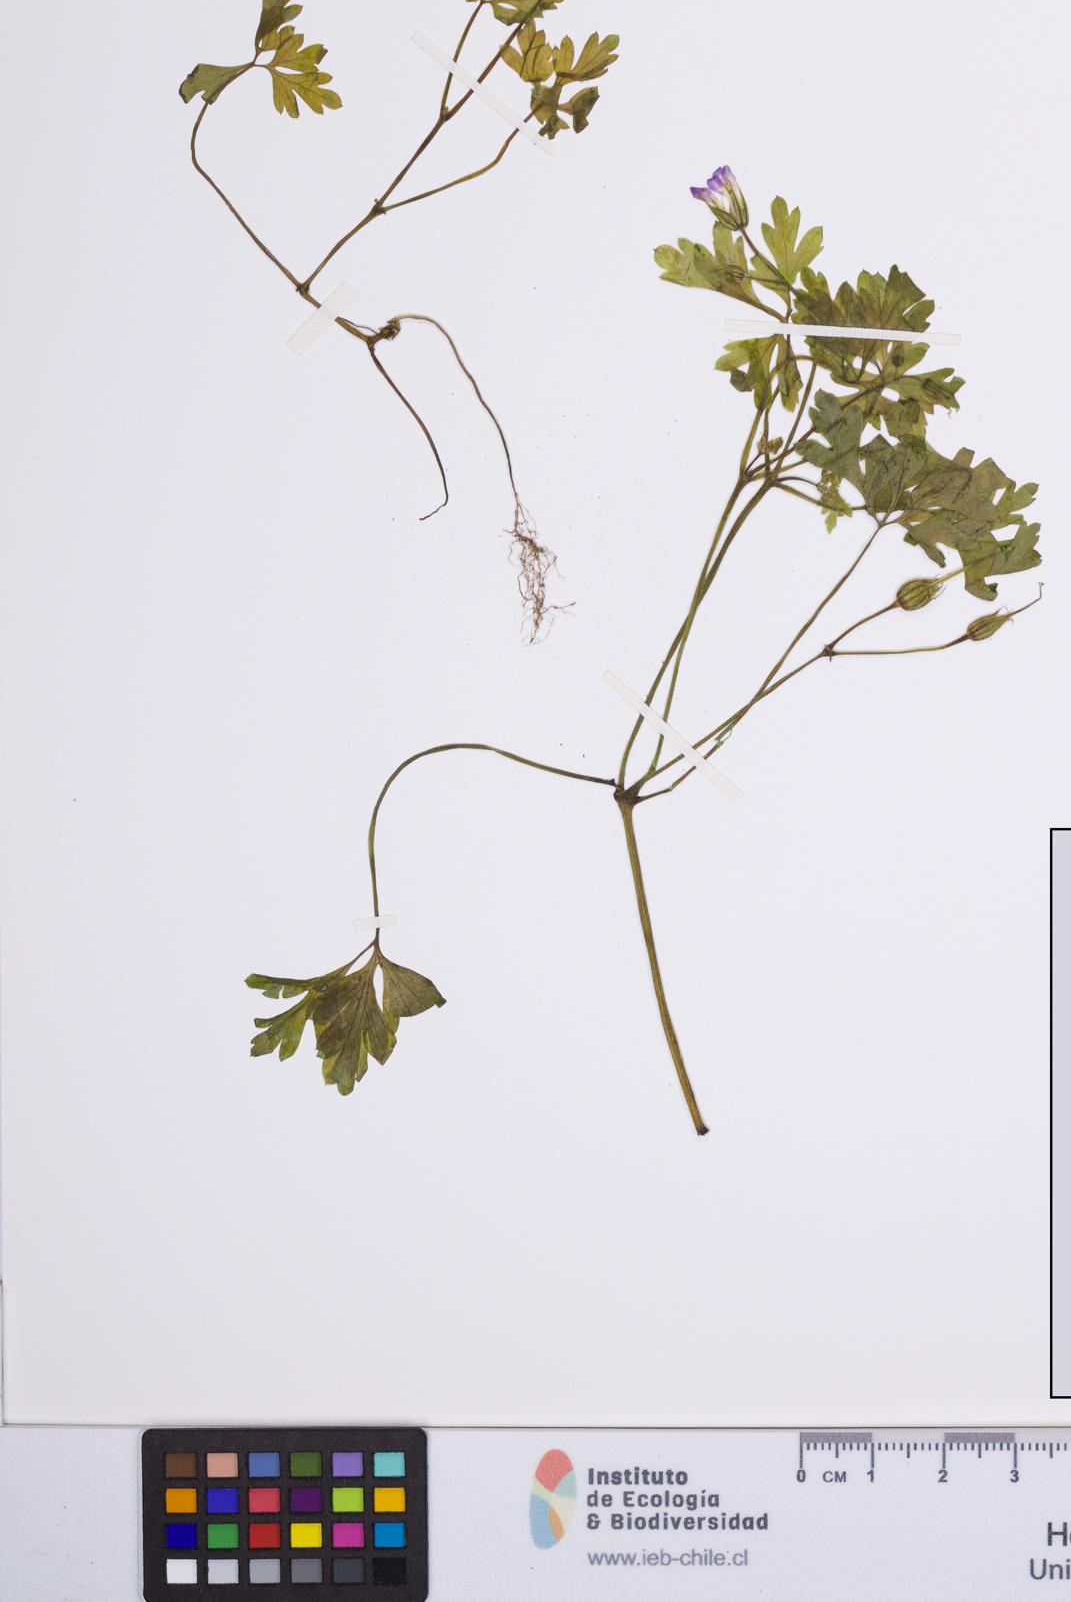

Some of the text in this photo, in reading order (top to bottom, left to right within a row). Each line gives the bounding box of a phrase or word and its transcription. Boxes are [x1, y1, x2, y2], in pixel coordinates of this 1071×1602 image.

[587, 1466, 689, 1486] Instituto
[795, 1468, 807, 1484] 0
[822, 1470, 847, 1484] CM
[866, 1469, 875, 1483] 1
[937, 1468, 949, 1484] 2
[1009, 1468, 1020, 1484] 3
[586, 1489, 720, 1511] de Ecología
[586, 1511, 769, 1531] & Biodiversidad
[587, 1548, 748, 1567] www.ieb-chile.cl
